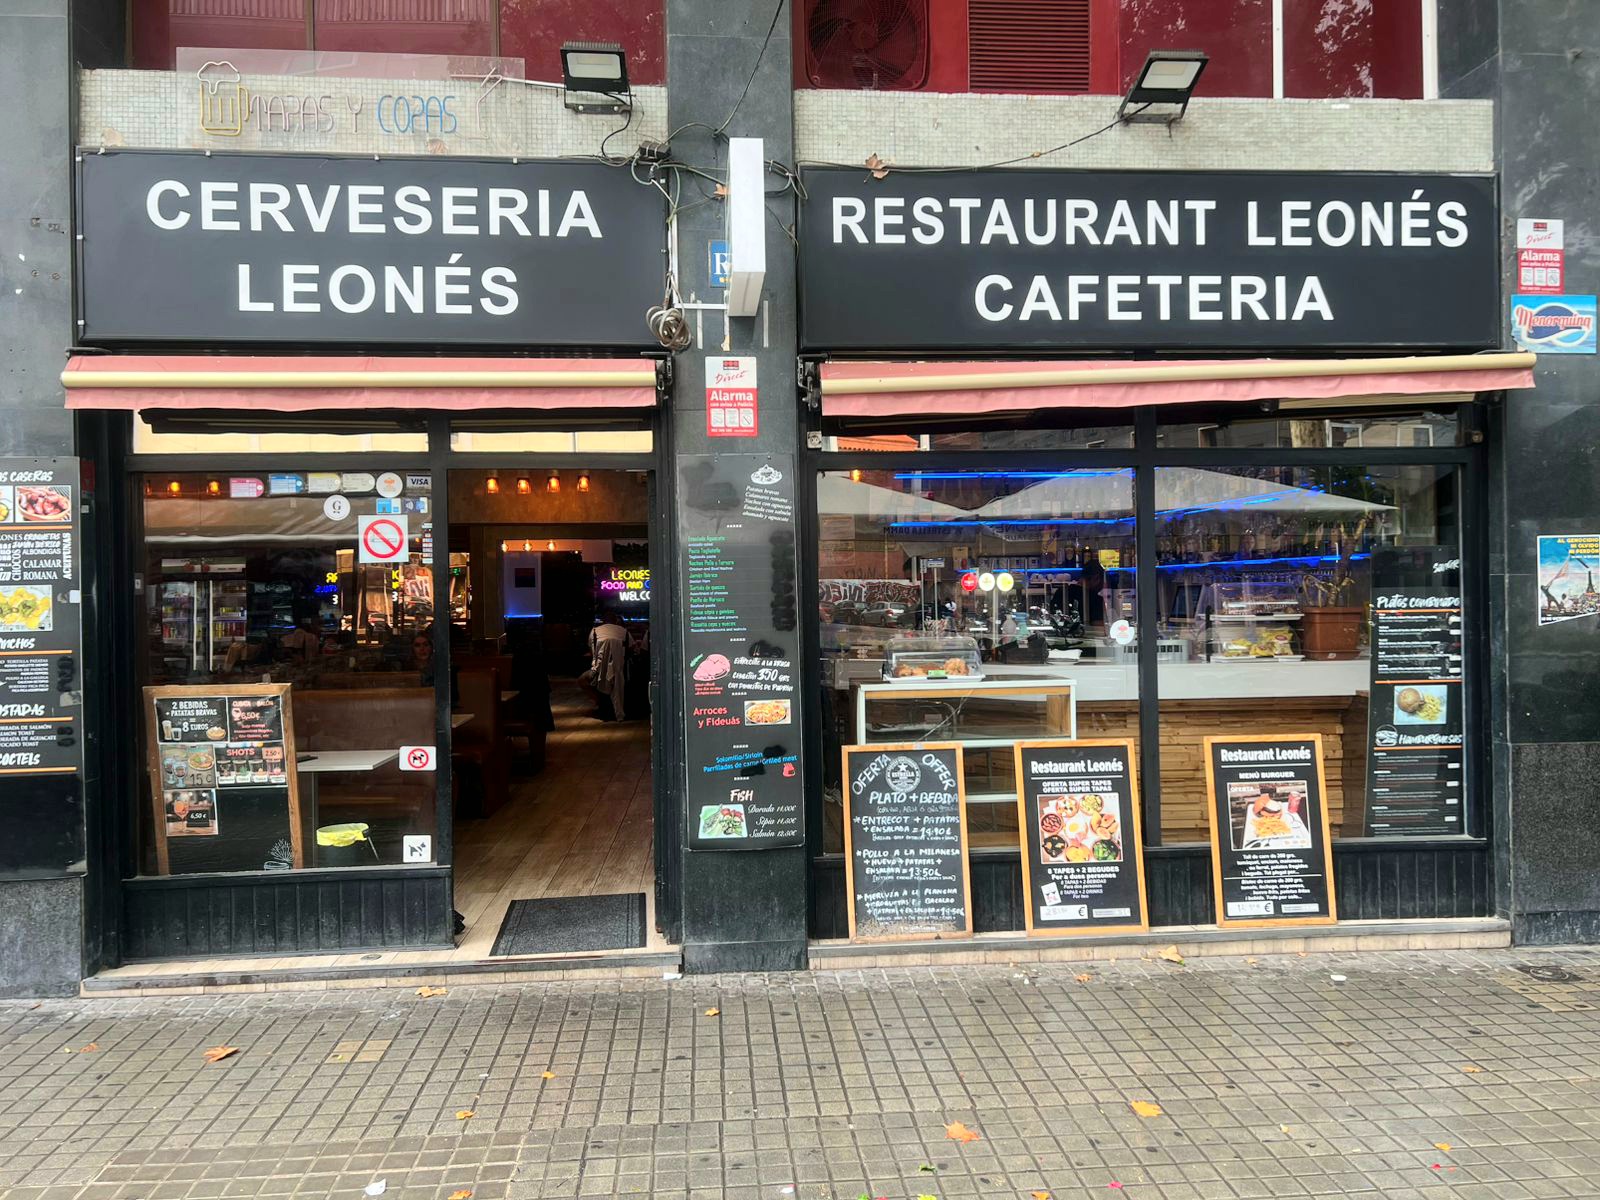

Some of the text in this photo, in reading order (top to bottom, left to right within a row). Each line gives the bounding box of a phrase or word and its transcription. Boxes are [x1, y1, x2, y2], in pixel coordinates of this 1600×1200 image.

[347, 96, 363, 132] Y
[378, 95, 457, 134] COPAS
[146, 180, 602, 238] CERVESERIA
[833, 190, 1469, 248] RESTAURANT LEONÉS
[1522, 251, 1559, 261] Alarma
[238, 253, 519, 315] LEONÉS
[975, 275, 1333, 321] CAFETERIA
[711, 390, 753, 401] Alarma
[333, 501, 341, 510] G
[12, 549, 21, 580] CHOCOS
[23, 560, 61, 568] CALAMAR
[23, 571, 58, 580] ROMANA
[601, 581, 625, 589] FOOD
[757, 668, 778, 681] 350
[179, 701, 208, 709] BEBIDAS
[694, 707, 727, 715] Arroces
[182, 722, 189, 732] 8
[698, 720, 704, 728] y
[227, 748, 255, 756] SHOTS
[1221, 746, 1311, 762] Restaurant Leonés
[922, 754, 956, 790] OFFER
[1031, 758, 1123, 774] Restaurant Leonés
[190, 773, 202, 786] 15
[852, 754, 891, 795] OFERTA
[869, 791, 958, 805] PLATO BEBIDA
[748, 804, 773, 813] Dorada
[923, 816, 960, 825] PATATAS
